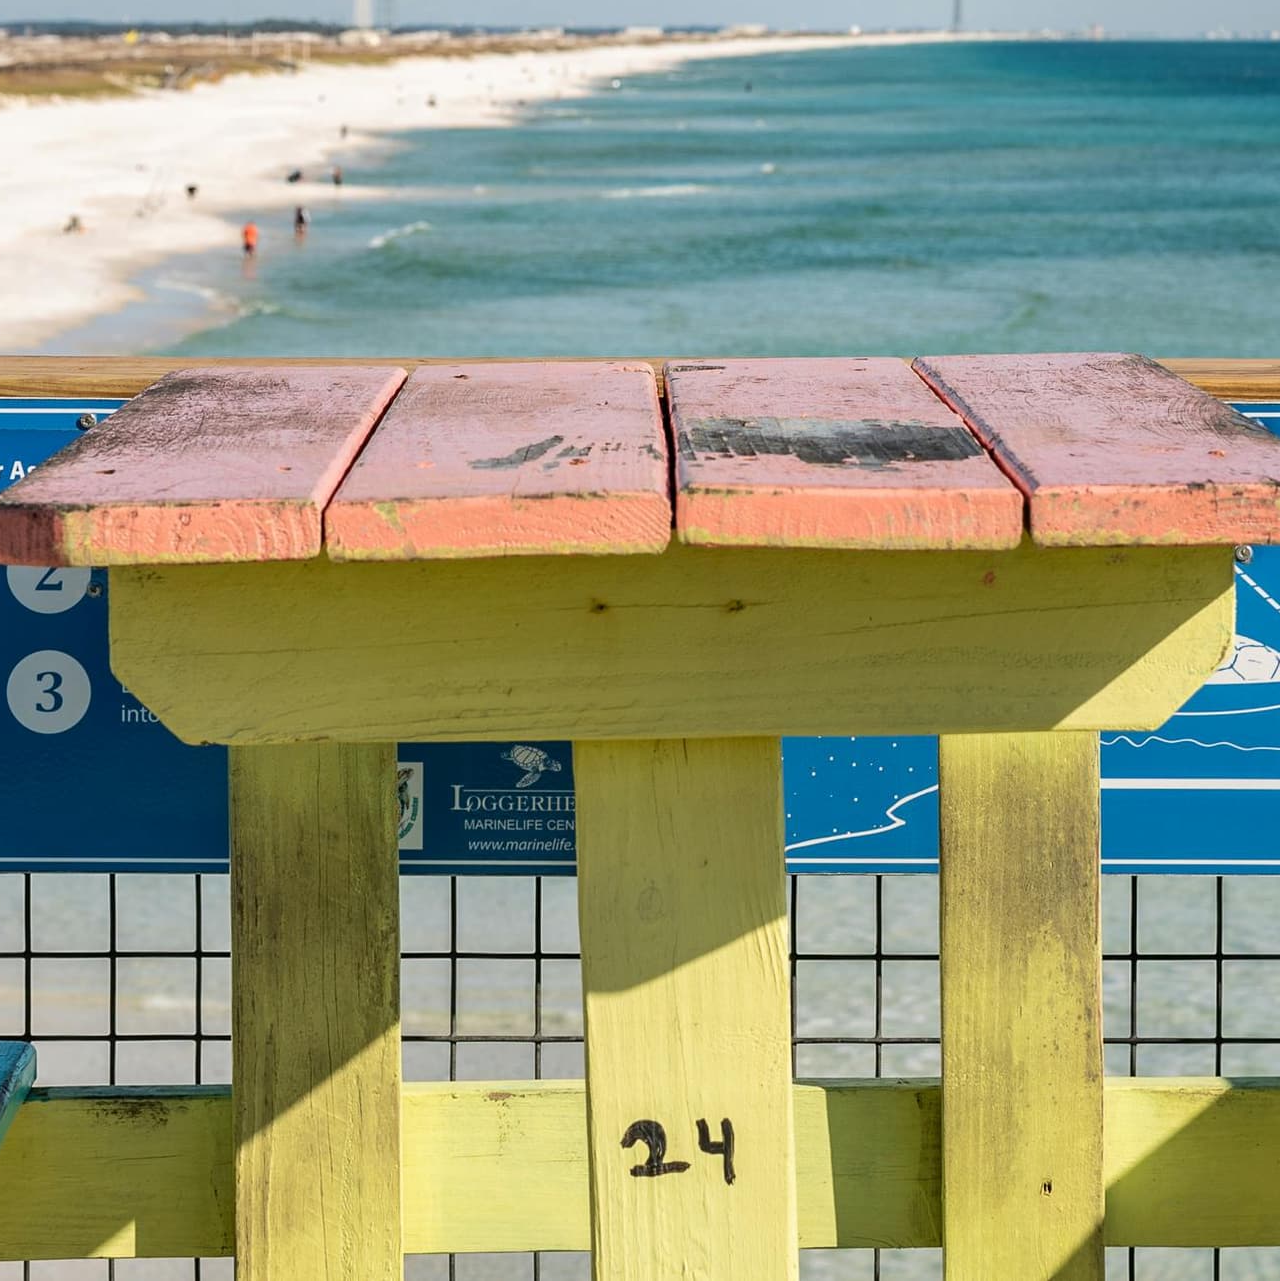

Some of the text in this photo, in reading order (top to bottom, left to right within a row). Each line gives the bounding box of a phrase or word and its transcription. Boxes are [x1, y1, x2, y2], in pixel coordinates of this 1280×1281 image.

[35, 671, 64, 713] 3
[464, 819, 543, 831] MARINELIFE
[620, 1118, 737, 1186] 24
